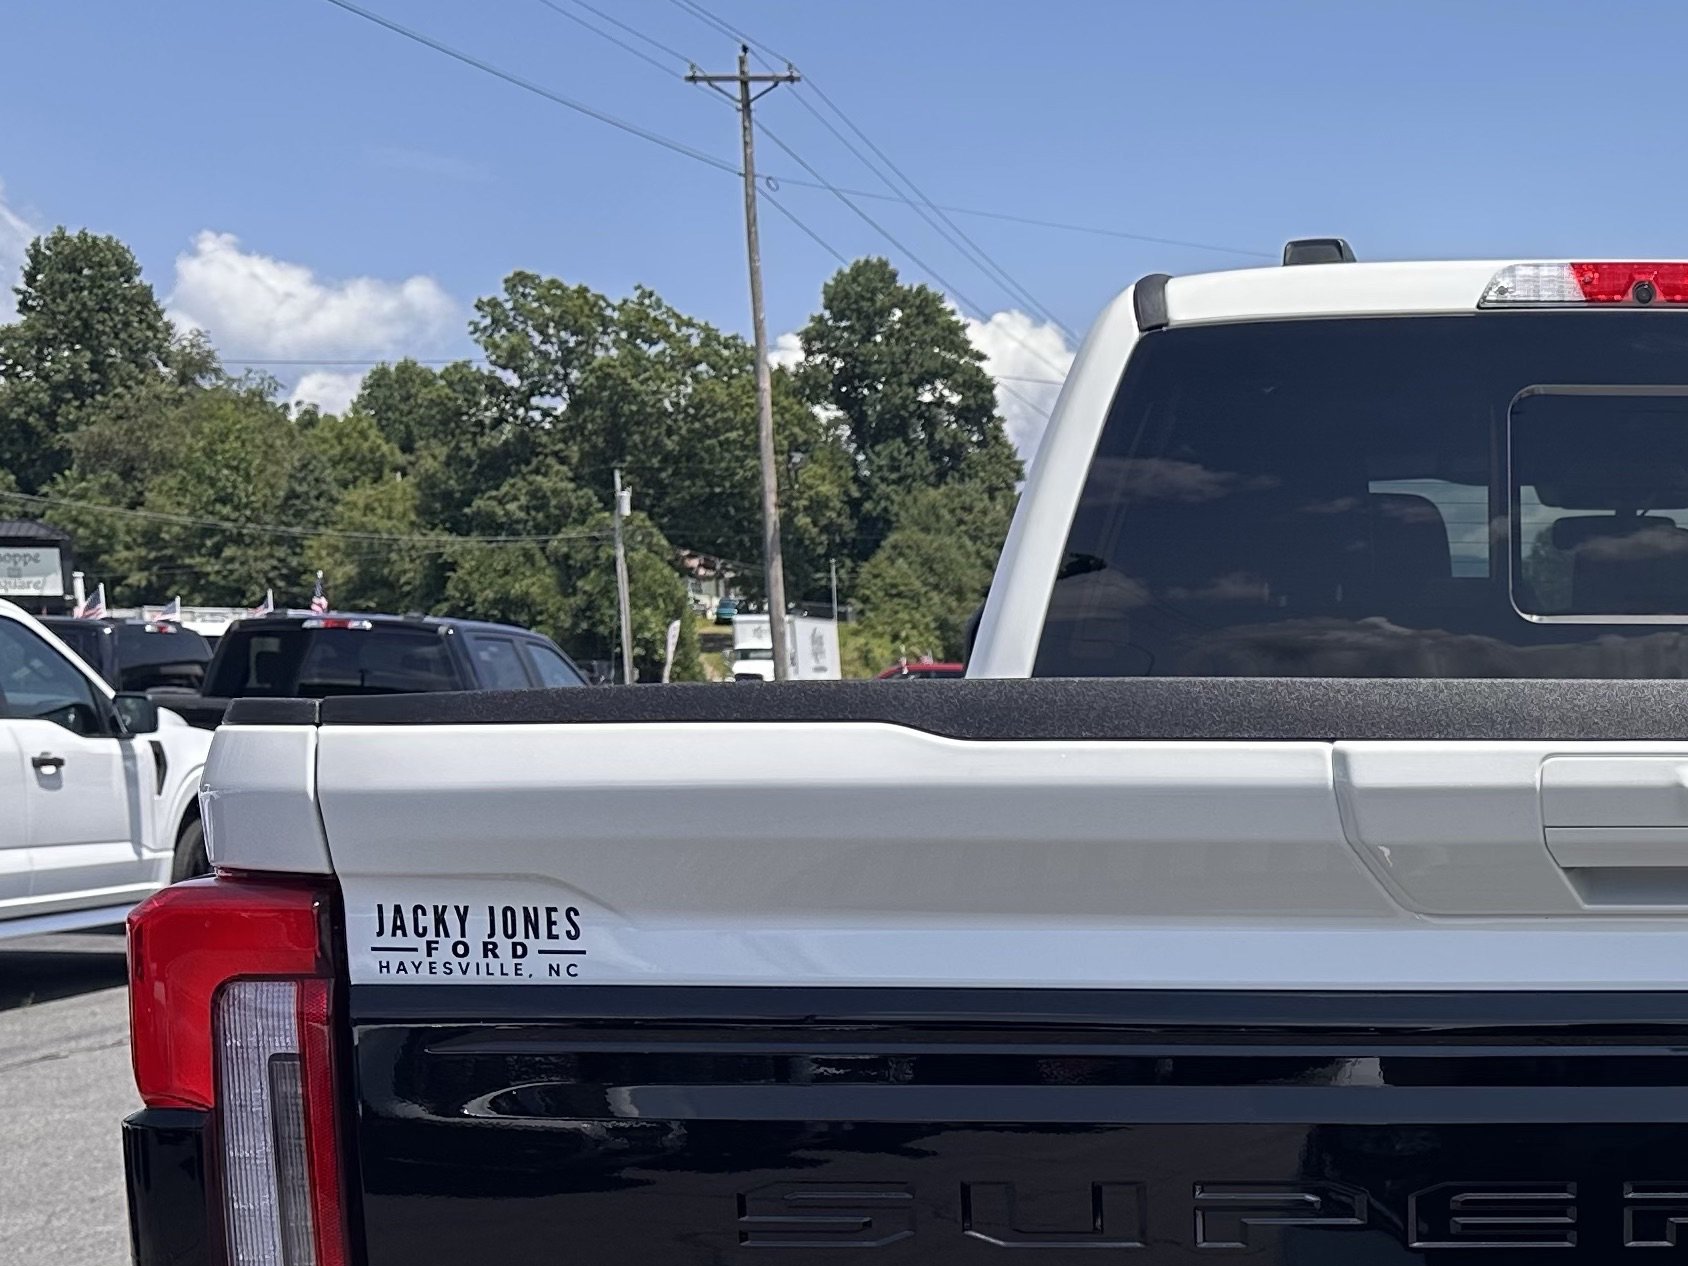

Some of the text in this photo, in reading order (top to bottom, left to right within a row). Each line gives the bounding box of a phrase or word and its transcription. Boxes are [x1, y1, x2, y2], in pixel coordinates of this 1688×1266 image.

[0, 552, 41, 567] oppe
[375, 903, 581, 941] JACKY JONES
[425, 940, 529, 959] FORD
[378, 960, 579, 979] HAYESVILLE, NC
